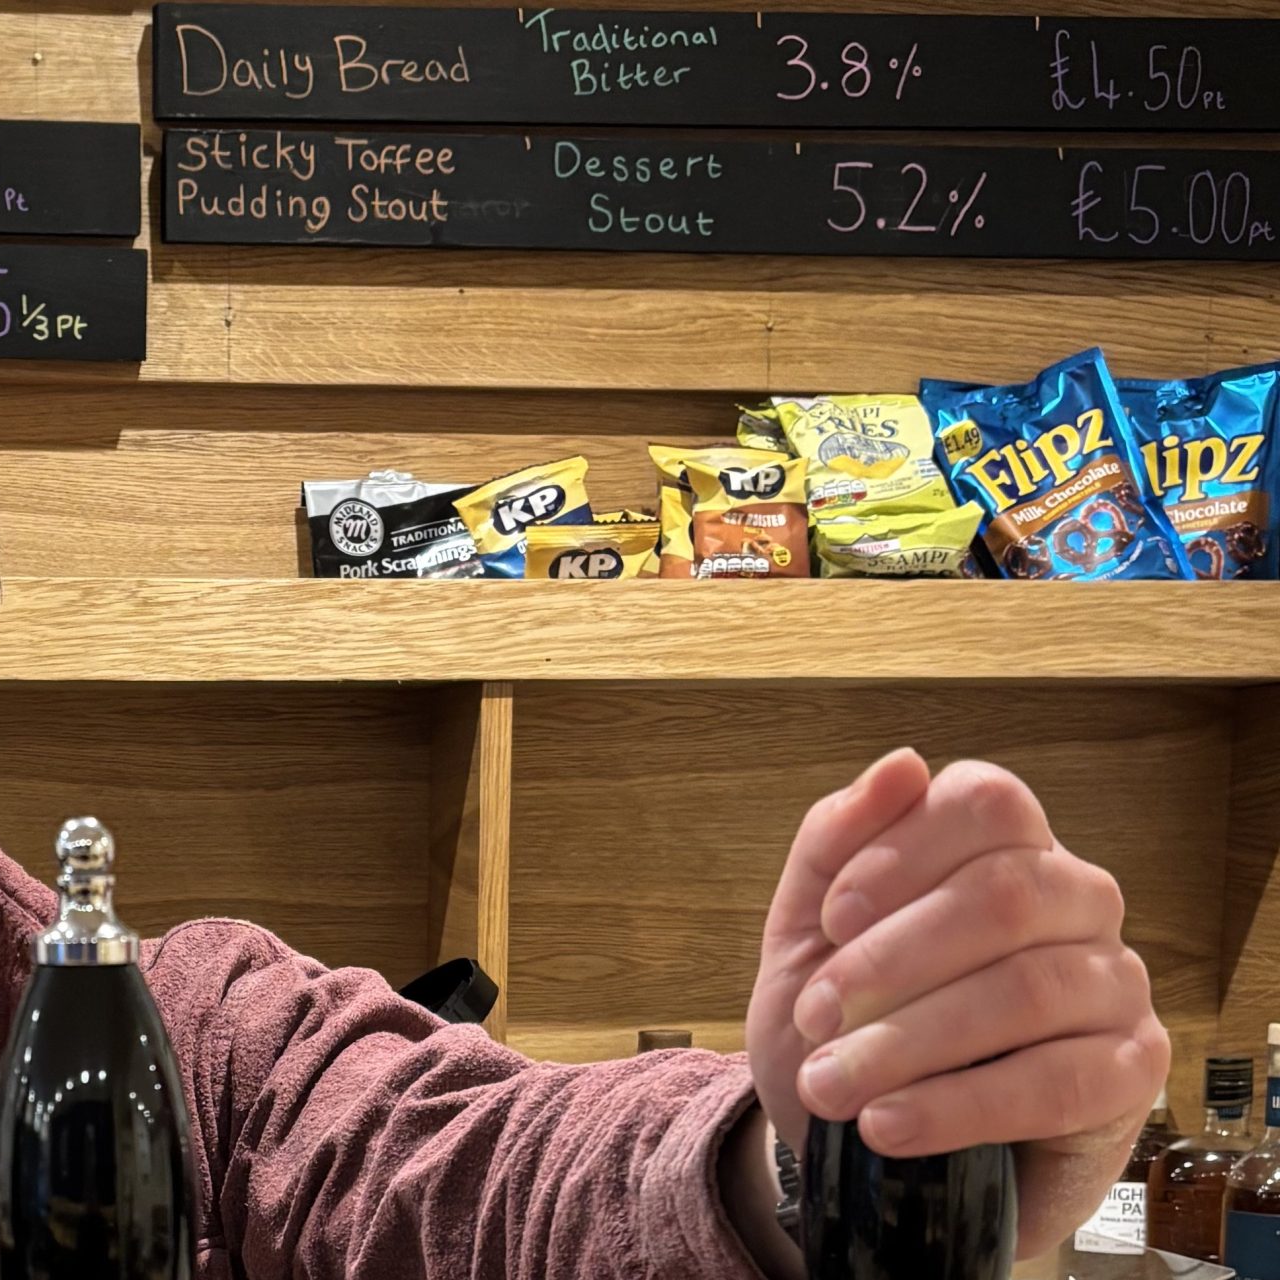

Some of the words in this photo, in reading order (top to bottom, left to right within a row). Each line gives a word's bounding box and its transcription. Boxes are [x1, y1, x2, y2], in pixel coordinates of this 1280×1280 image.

[525, 8, 717, 54] Traditional
[176, 23, 314, 99] Daily
[333, 34, 471, 94] Bread
[572, 57, 690, 96] Bitter
[776, 34, 922, 100] 3.8%
[1050, 30, 1202, 112] £4.50
[176, 132, 316, 181] Sticky
[334, 136, 456, 176] Toffee
[553, 142, 723, 182] Dessert
[177, 180, 330, 232] Pudding
[348, 185, 448, 222] Stout
[588, 194, 715, 236] Stout
[827, 161, 987, 236] 5.2%
[1071, 160, 1251, 244] £5.00
[965, 408, 1114, 514] Flipz
[333, 503, 379, 528] MIDLAND
[497, 487, 559, 532] KP
[1012, 503, 1046, 526] Milk
[1044, 461, 1122, 508] Chocolate
[335, 535, 378, 554] SNACKS
[391, 521, 469, 548] TRADITIONA
[339, 559, 379, 579] Pork
[558, 553, 618, 578] KP
